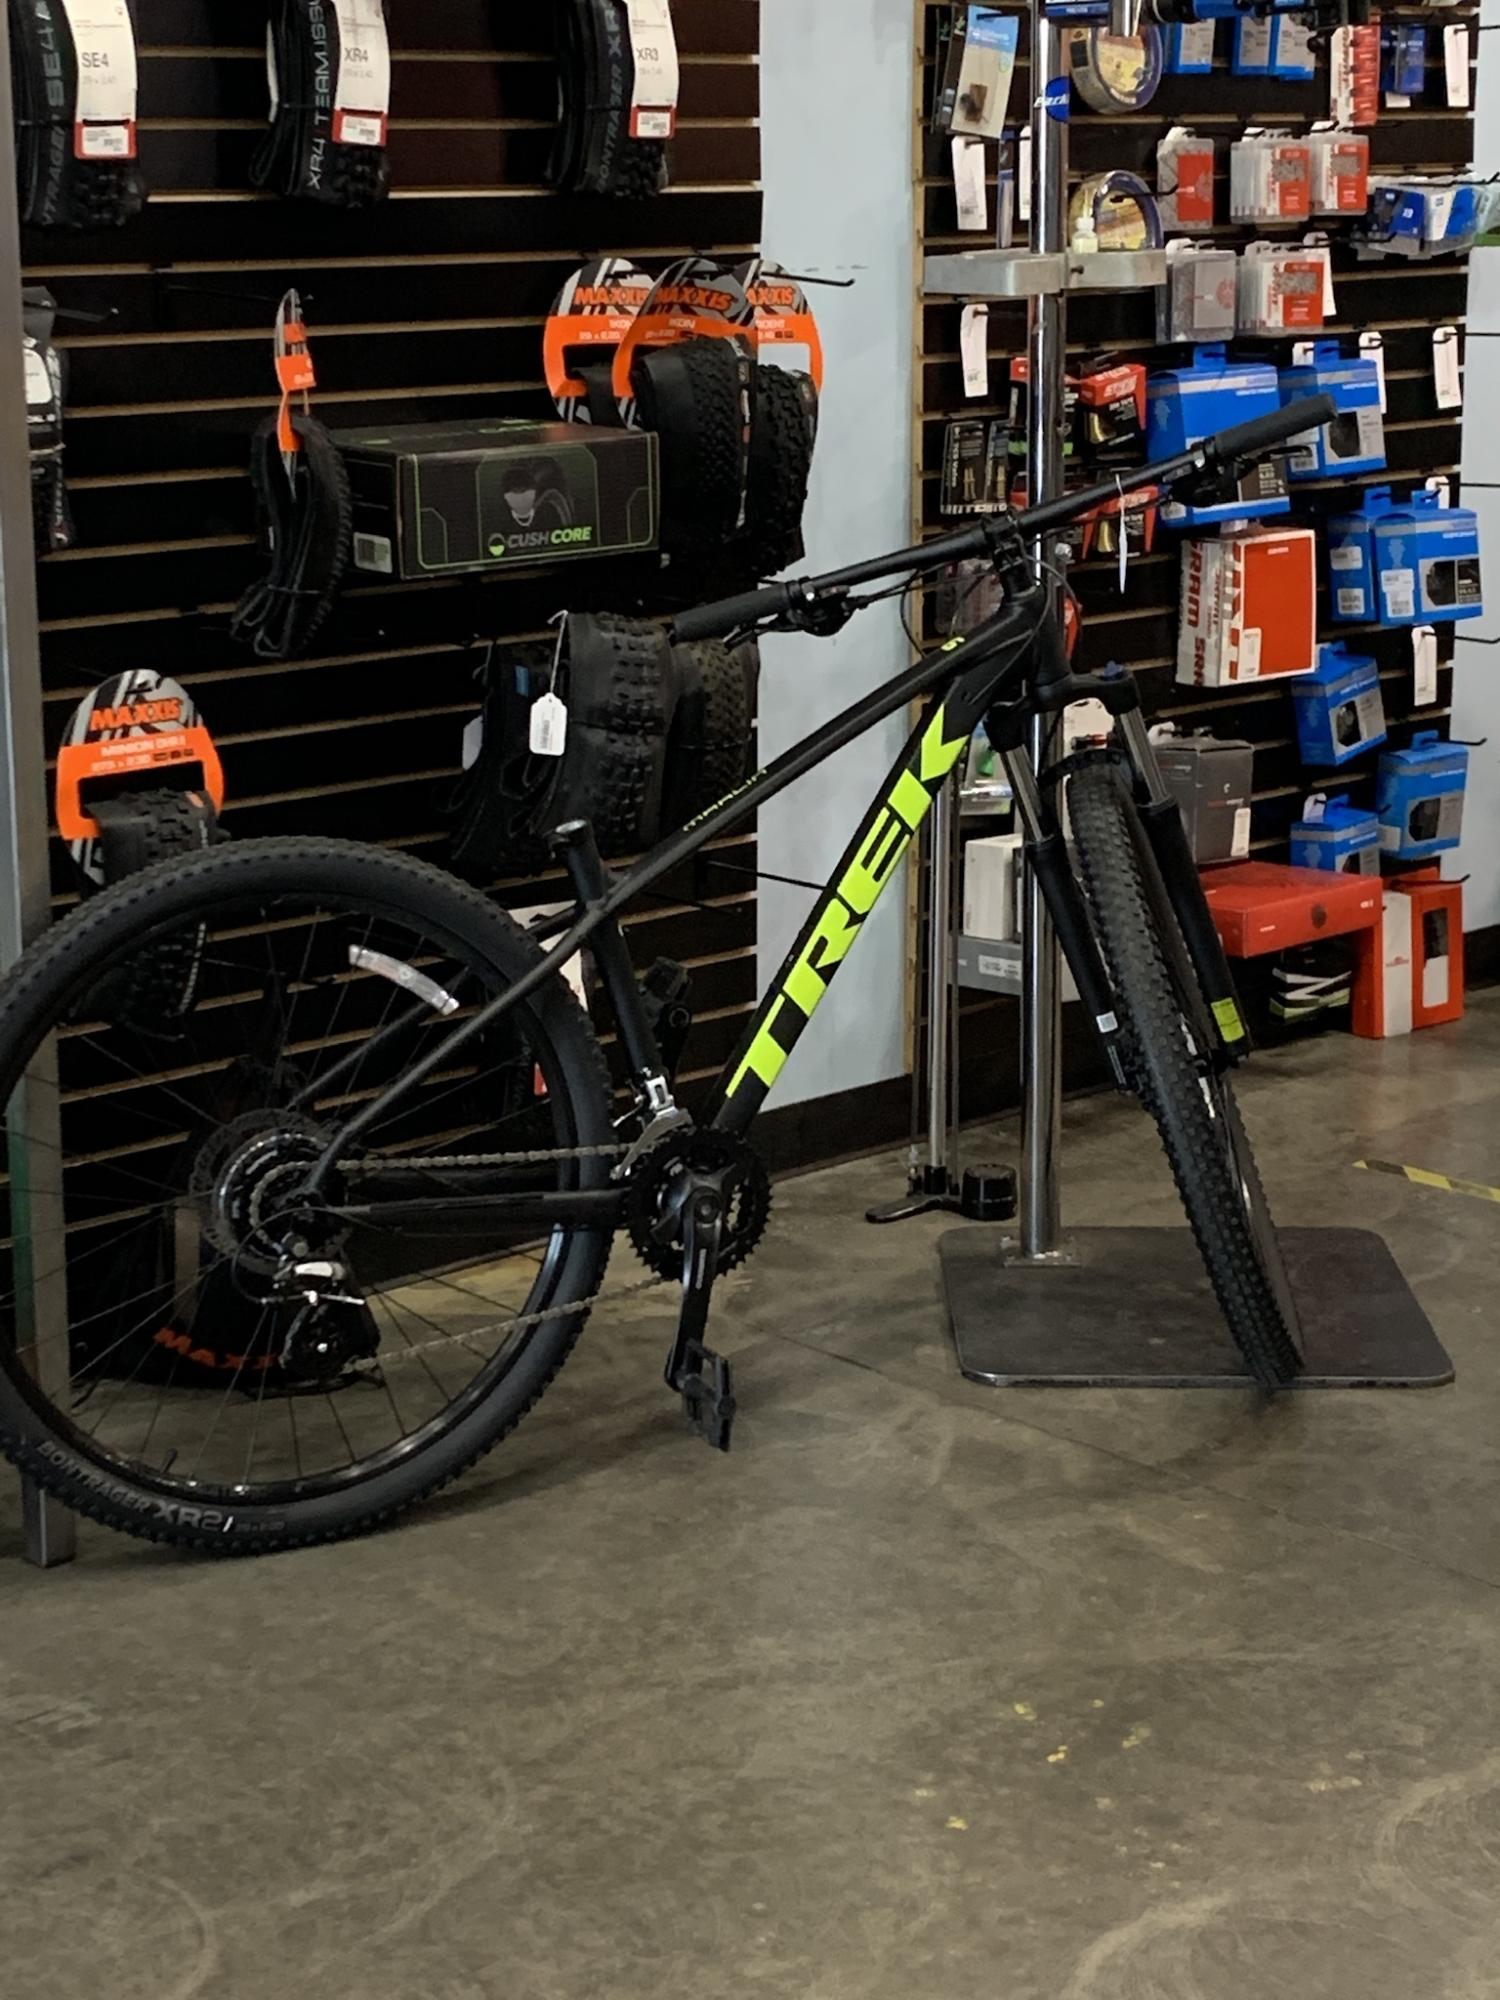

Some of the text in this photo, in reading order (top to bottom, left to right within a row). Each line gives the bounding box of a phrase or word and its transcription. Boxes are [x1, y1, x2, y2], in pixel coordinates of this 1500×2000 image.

[604, 0, 622, 57] XR
[81, 52, 110, 68] SE4
[344, 48, 369, 63] XR4
[636, 48, 659, 62] XR3
[313, 51, 331, 125] TEAM
[307, 137, 327, 190] XR4
[746, 286, 794, 306] AXXIS
[508, 526, 593, 548] CUSH CORE
[90, 698, 182, 732] MAXXIS
[724, 703, 972, 1098] TREK
[37, 1440, 223, 1531] BONTRAGER XR2
